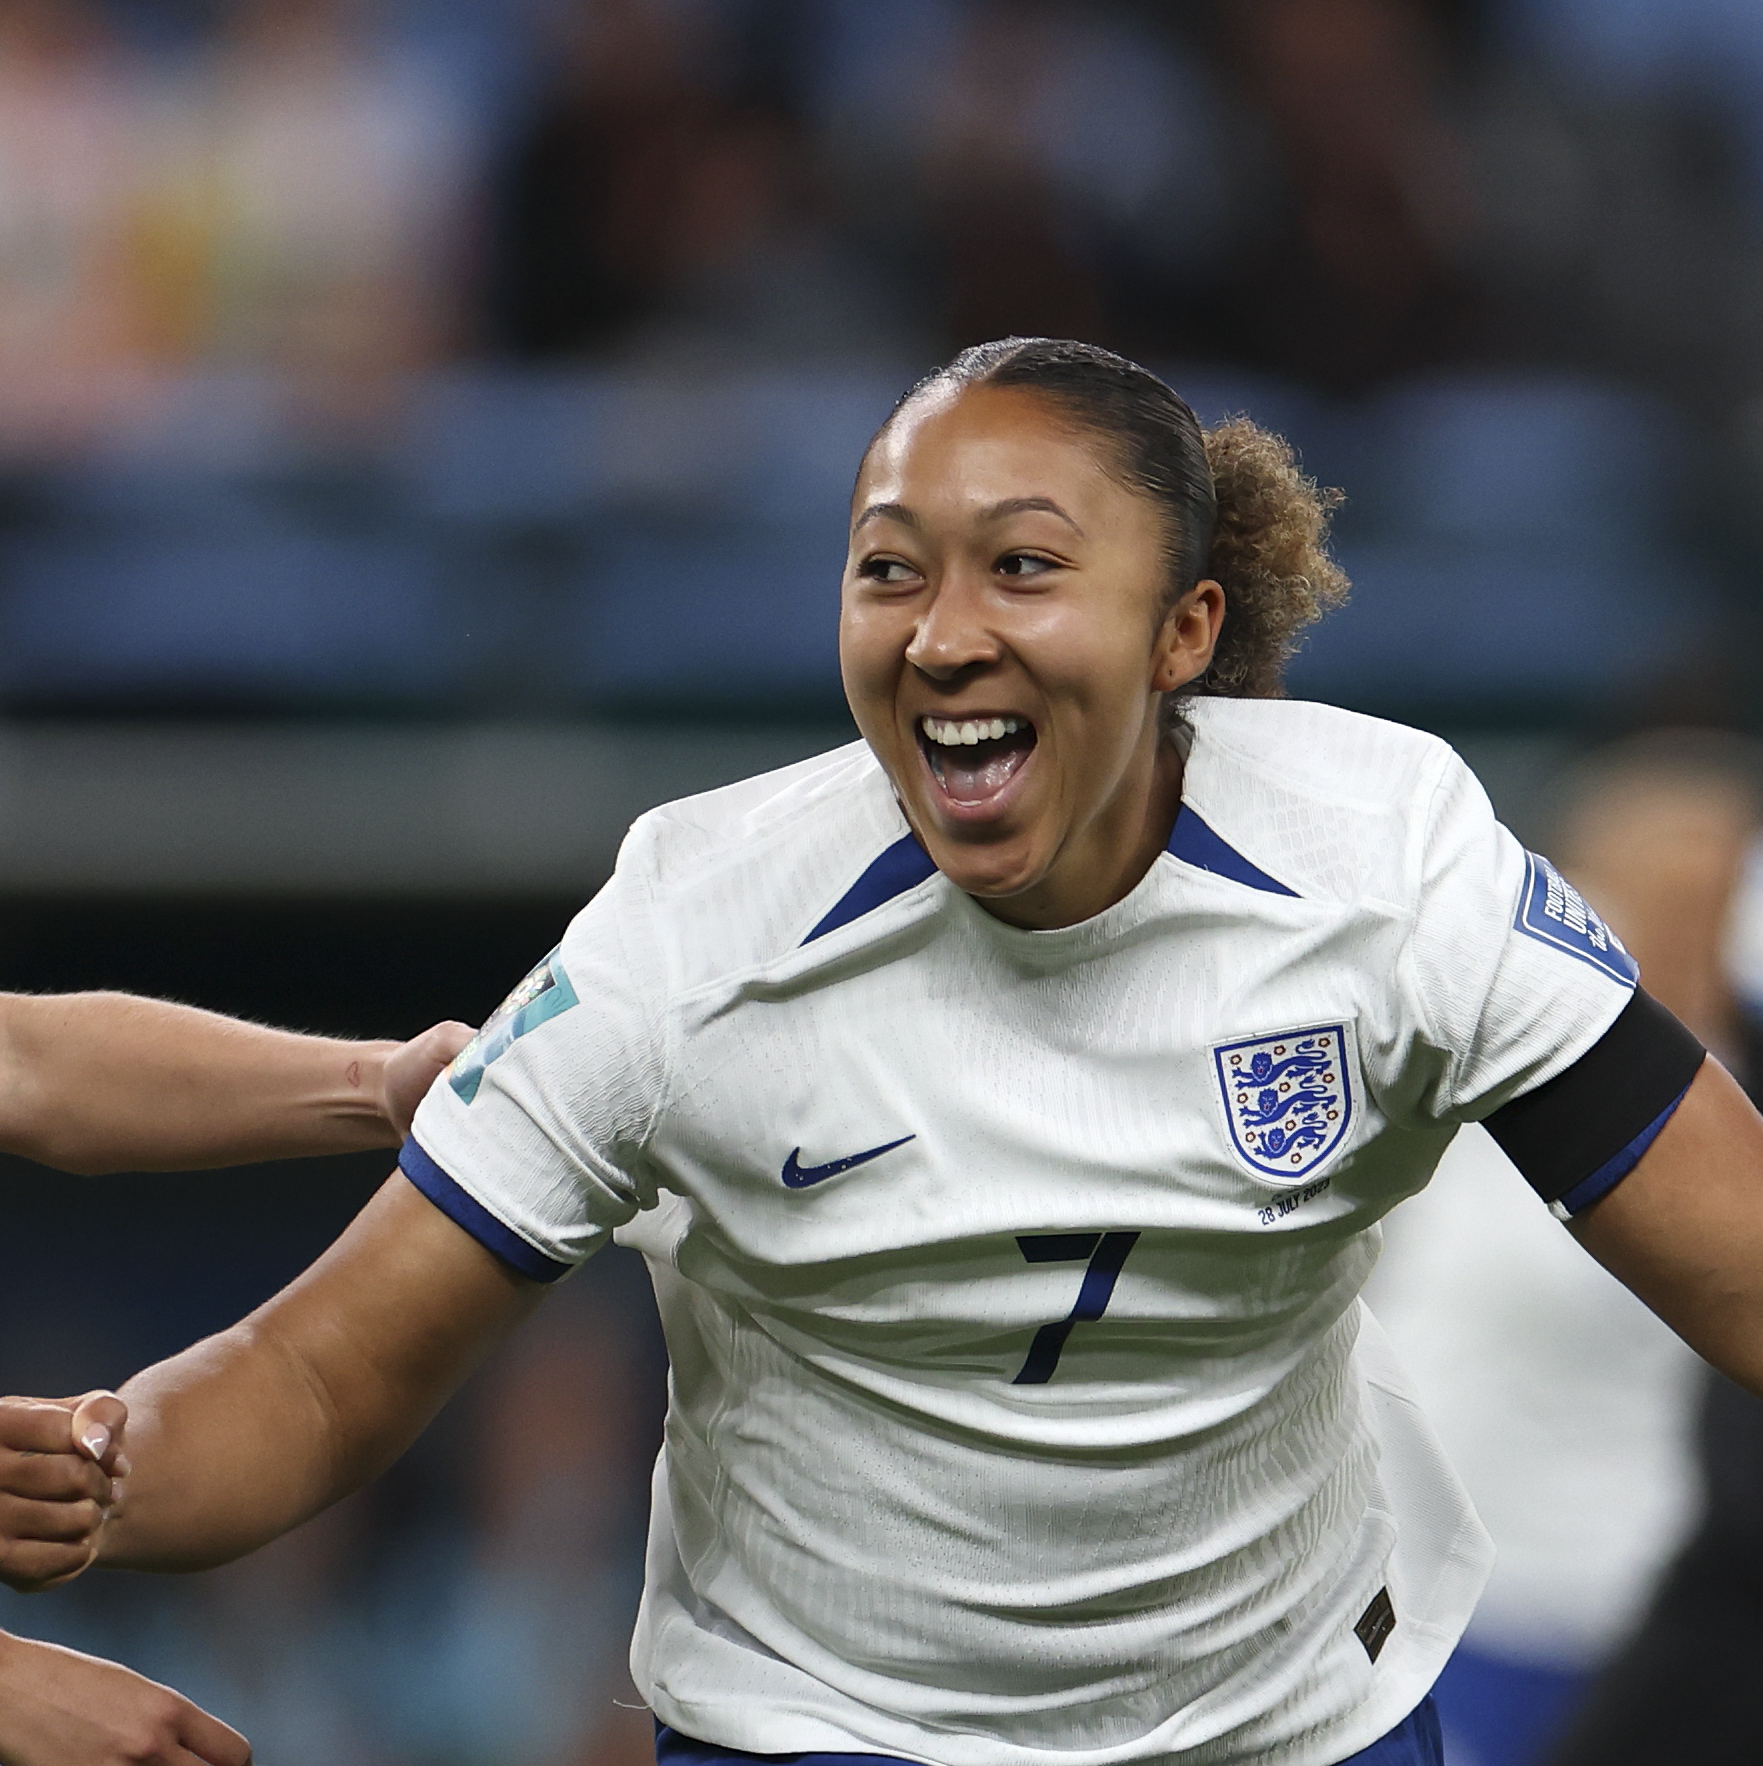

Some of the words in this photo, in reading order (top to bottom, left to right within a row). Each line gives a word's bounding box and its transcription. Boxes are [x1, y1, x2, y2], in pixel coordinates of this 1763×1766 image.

[1257, 1206, 1276, 1226] 28
[1276, 1192, 1300, 1218] JULY
[1011, 1231, 1142, 1385] 7
